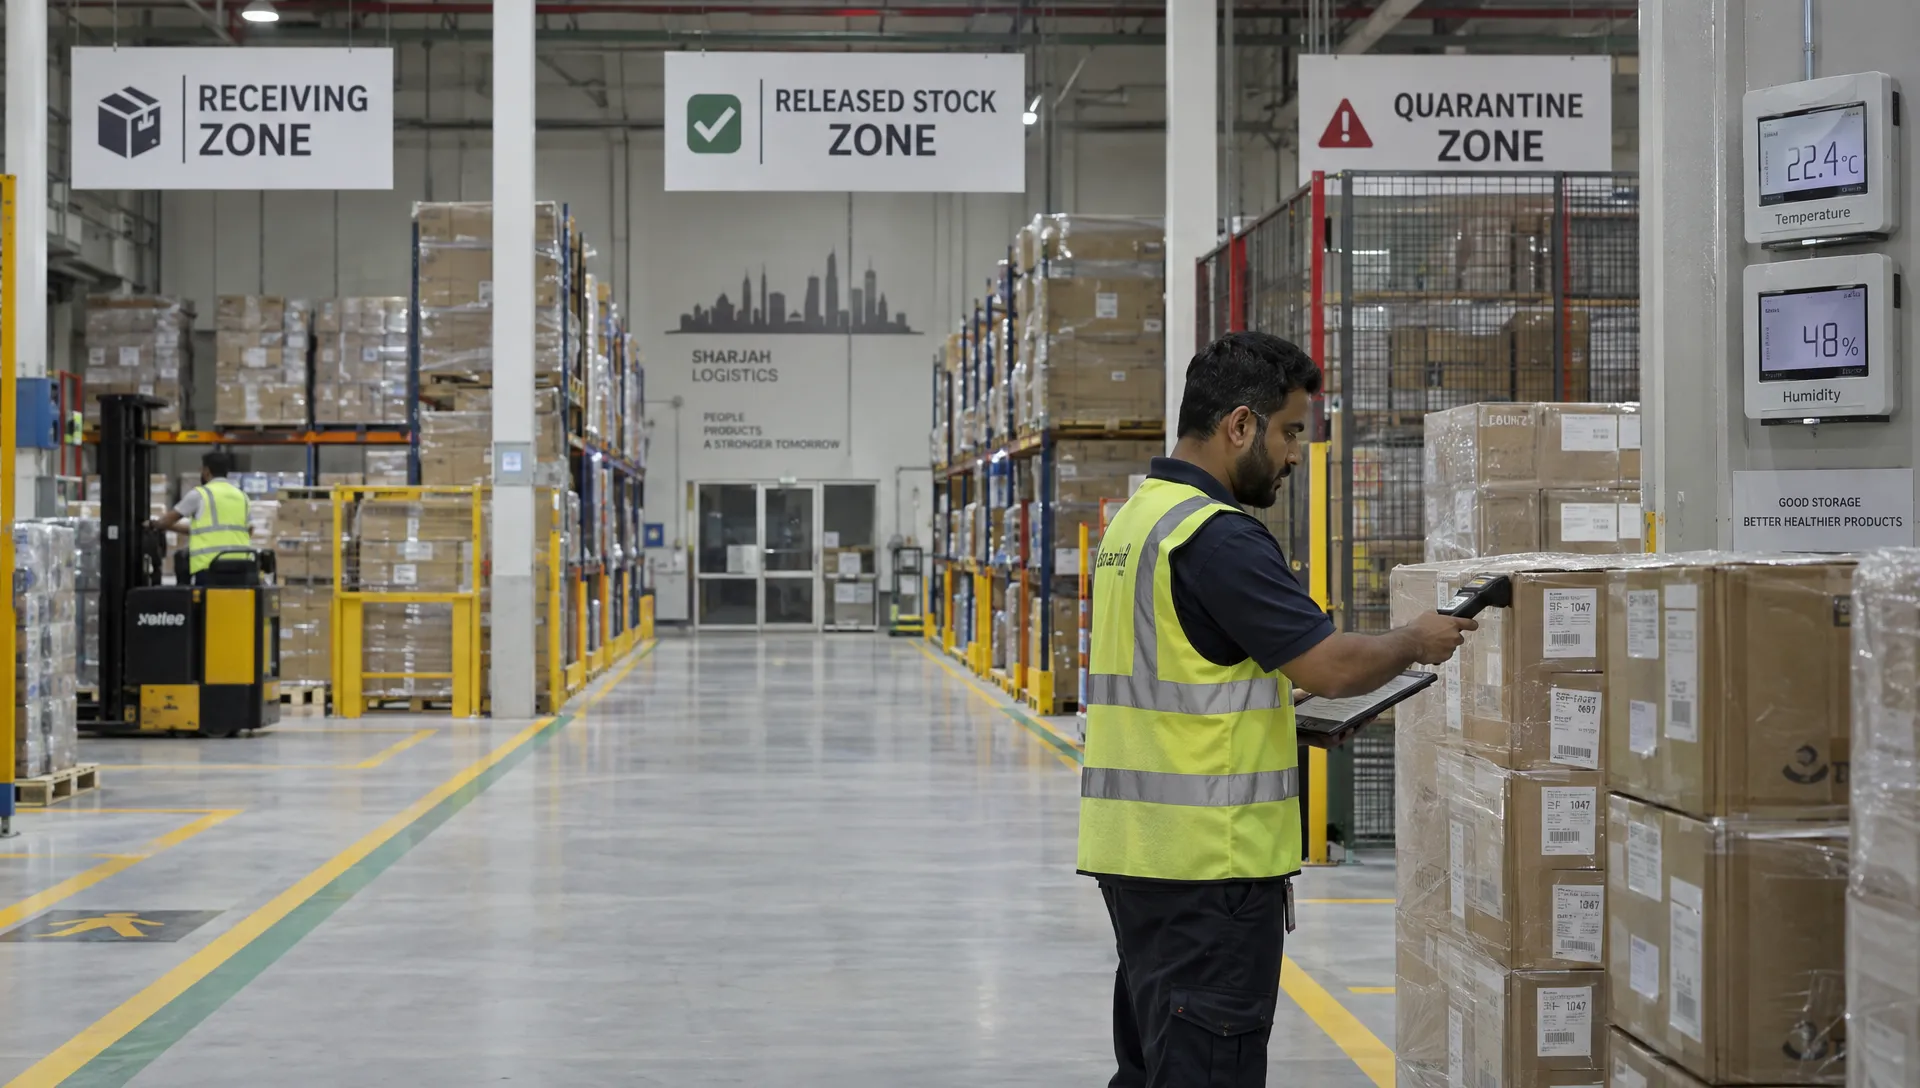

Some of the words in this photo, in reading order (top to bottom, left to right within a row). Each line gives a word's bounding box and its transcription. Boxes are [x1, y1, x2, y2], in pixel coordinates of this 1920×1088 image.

[199, 84, 369, 112] RECEIVING
[775, 88, 905, 113] RELEASED
[912, 88, 997, 114] STOCK
[1394, 92, 1584, 119] QUARANTINE
[199, 122, 312, 157] ZONE
[828, 123, 937, 157] ZONE
[1437, 129, 1545, 163] ZONE
[1775, 208, 1851, 226] Temperature
[691, 349, 772, 365] SHARJAH
[691, 368, 778, 383] LOGISTICS
[1783, 389, 1841, 404] Humidity
[703, 412, 745, 423] PEOPLE
[703, 426, 763, 437] PRODUCTS
[703, 440, 712, 450] A
[714, 440, 772, 450] STRONGER
[775, 440, 841, 450] TOMORROW
[1778, 497, 1809, 508] GOOD
[1812, 497, 1862, 508] STORAGE
[1743, 516, 1782, 527] BETTER
[1784, 516, 1842, 527] HEALTHIER
[1844, 516, 1903, 527] PRODUCTS
[1570, 602, 1591, 613] 1047
[1570, 800, 1591, 810] 1047
